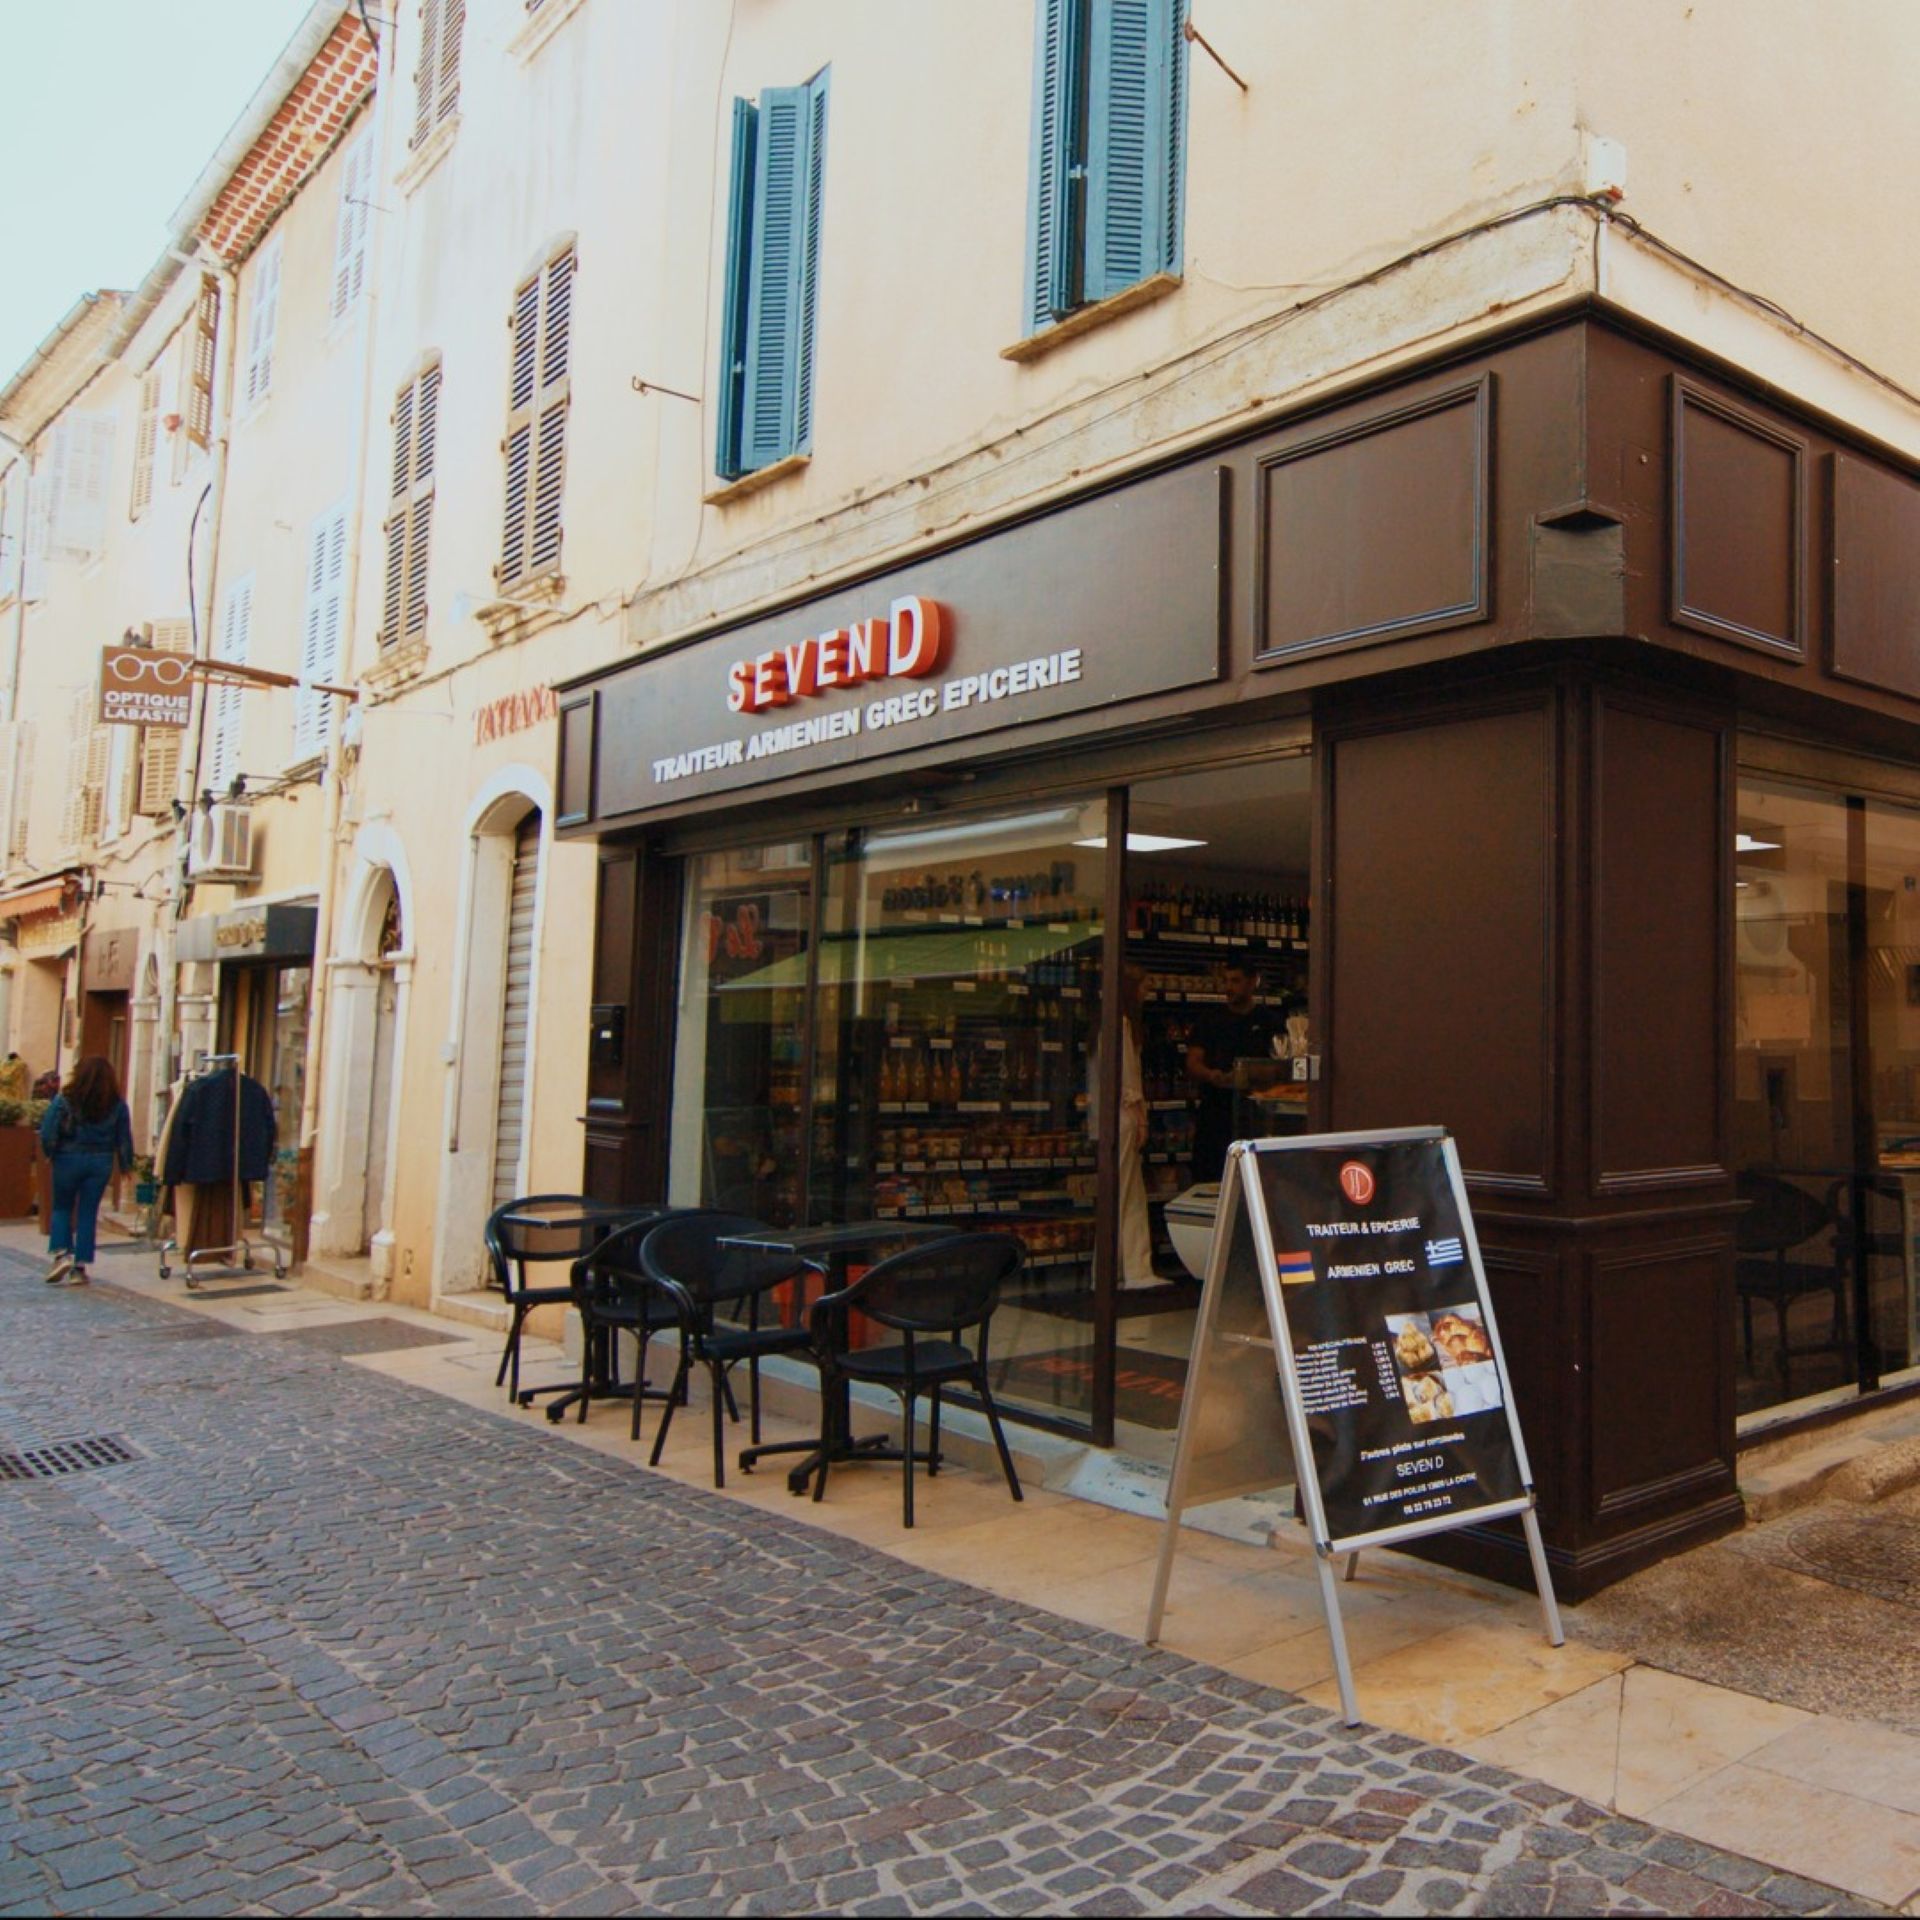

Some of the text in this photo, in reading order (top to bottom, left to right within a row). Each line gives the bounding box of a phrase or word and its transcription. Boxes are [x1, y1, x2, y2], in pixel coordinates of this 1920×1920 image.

[727, 617, 887, 714] SEVEN
[104, 690, 189, 709] OPTIQUE
[104, 706, 188, 725] LABASTIE
[653, 648, 1082, 784] TRAITEUR ARMENIEN GREC EPICERIE
[1305, 1216, 1421, 1238] TRAITEUR & EPICERIE
[1327, 1259, 1415, 1279] ARMENIEN GREC
[1396, 1454, 1444, 1477] SEVEN D
[1373, 1492, 1388, 1503] RUE
